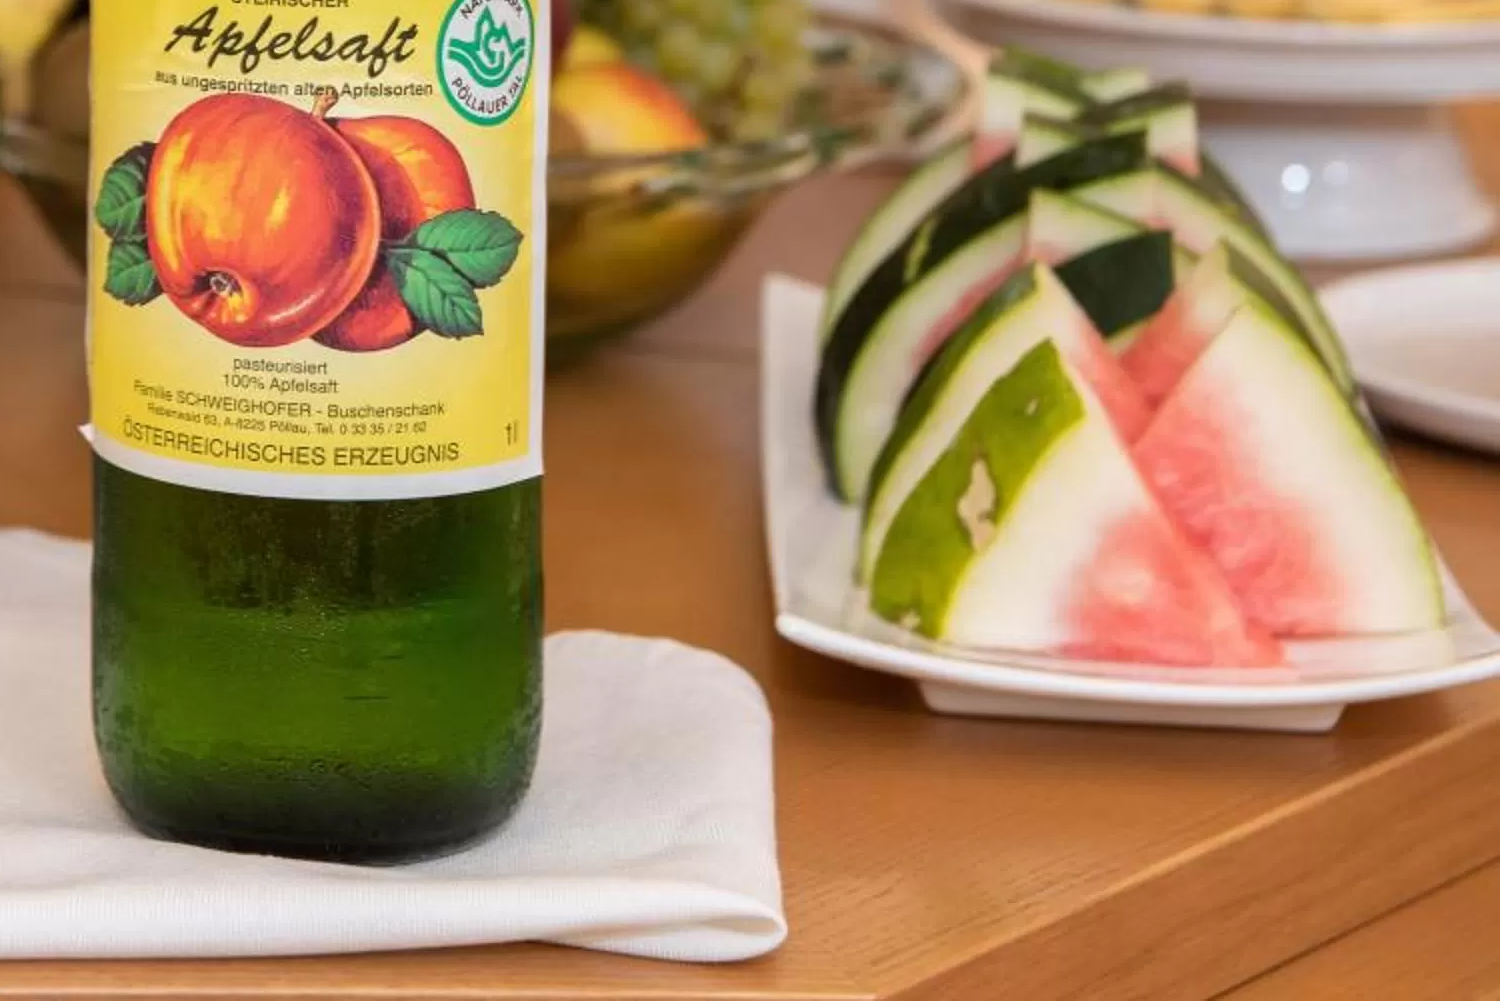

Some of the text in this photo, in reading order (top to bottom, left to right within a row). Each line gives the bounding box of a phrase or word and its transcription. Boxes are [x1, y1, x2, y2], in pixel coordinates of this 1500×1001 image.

[163, 6, 418, 78] Apfelsaft
[155, 70, 433, 100] aus ungespritzten alten Apfelsorten
[452, 77, 508, 114] PÖLLAUER
[223, 373, 339, 395] 100% Apfelsaft
[233, 358, 327, 376] pasteurisiert
[134, 379, 173, 401] Familie
[176, 390, 311, 418] SCHWEIGHOFER
[327, 401, 445, 419] Buschenschank
[124, 415, 459, 466] ÖSTERREICHISCHES ERZEUGNIS
